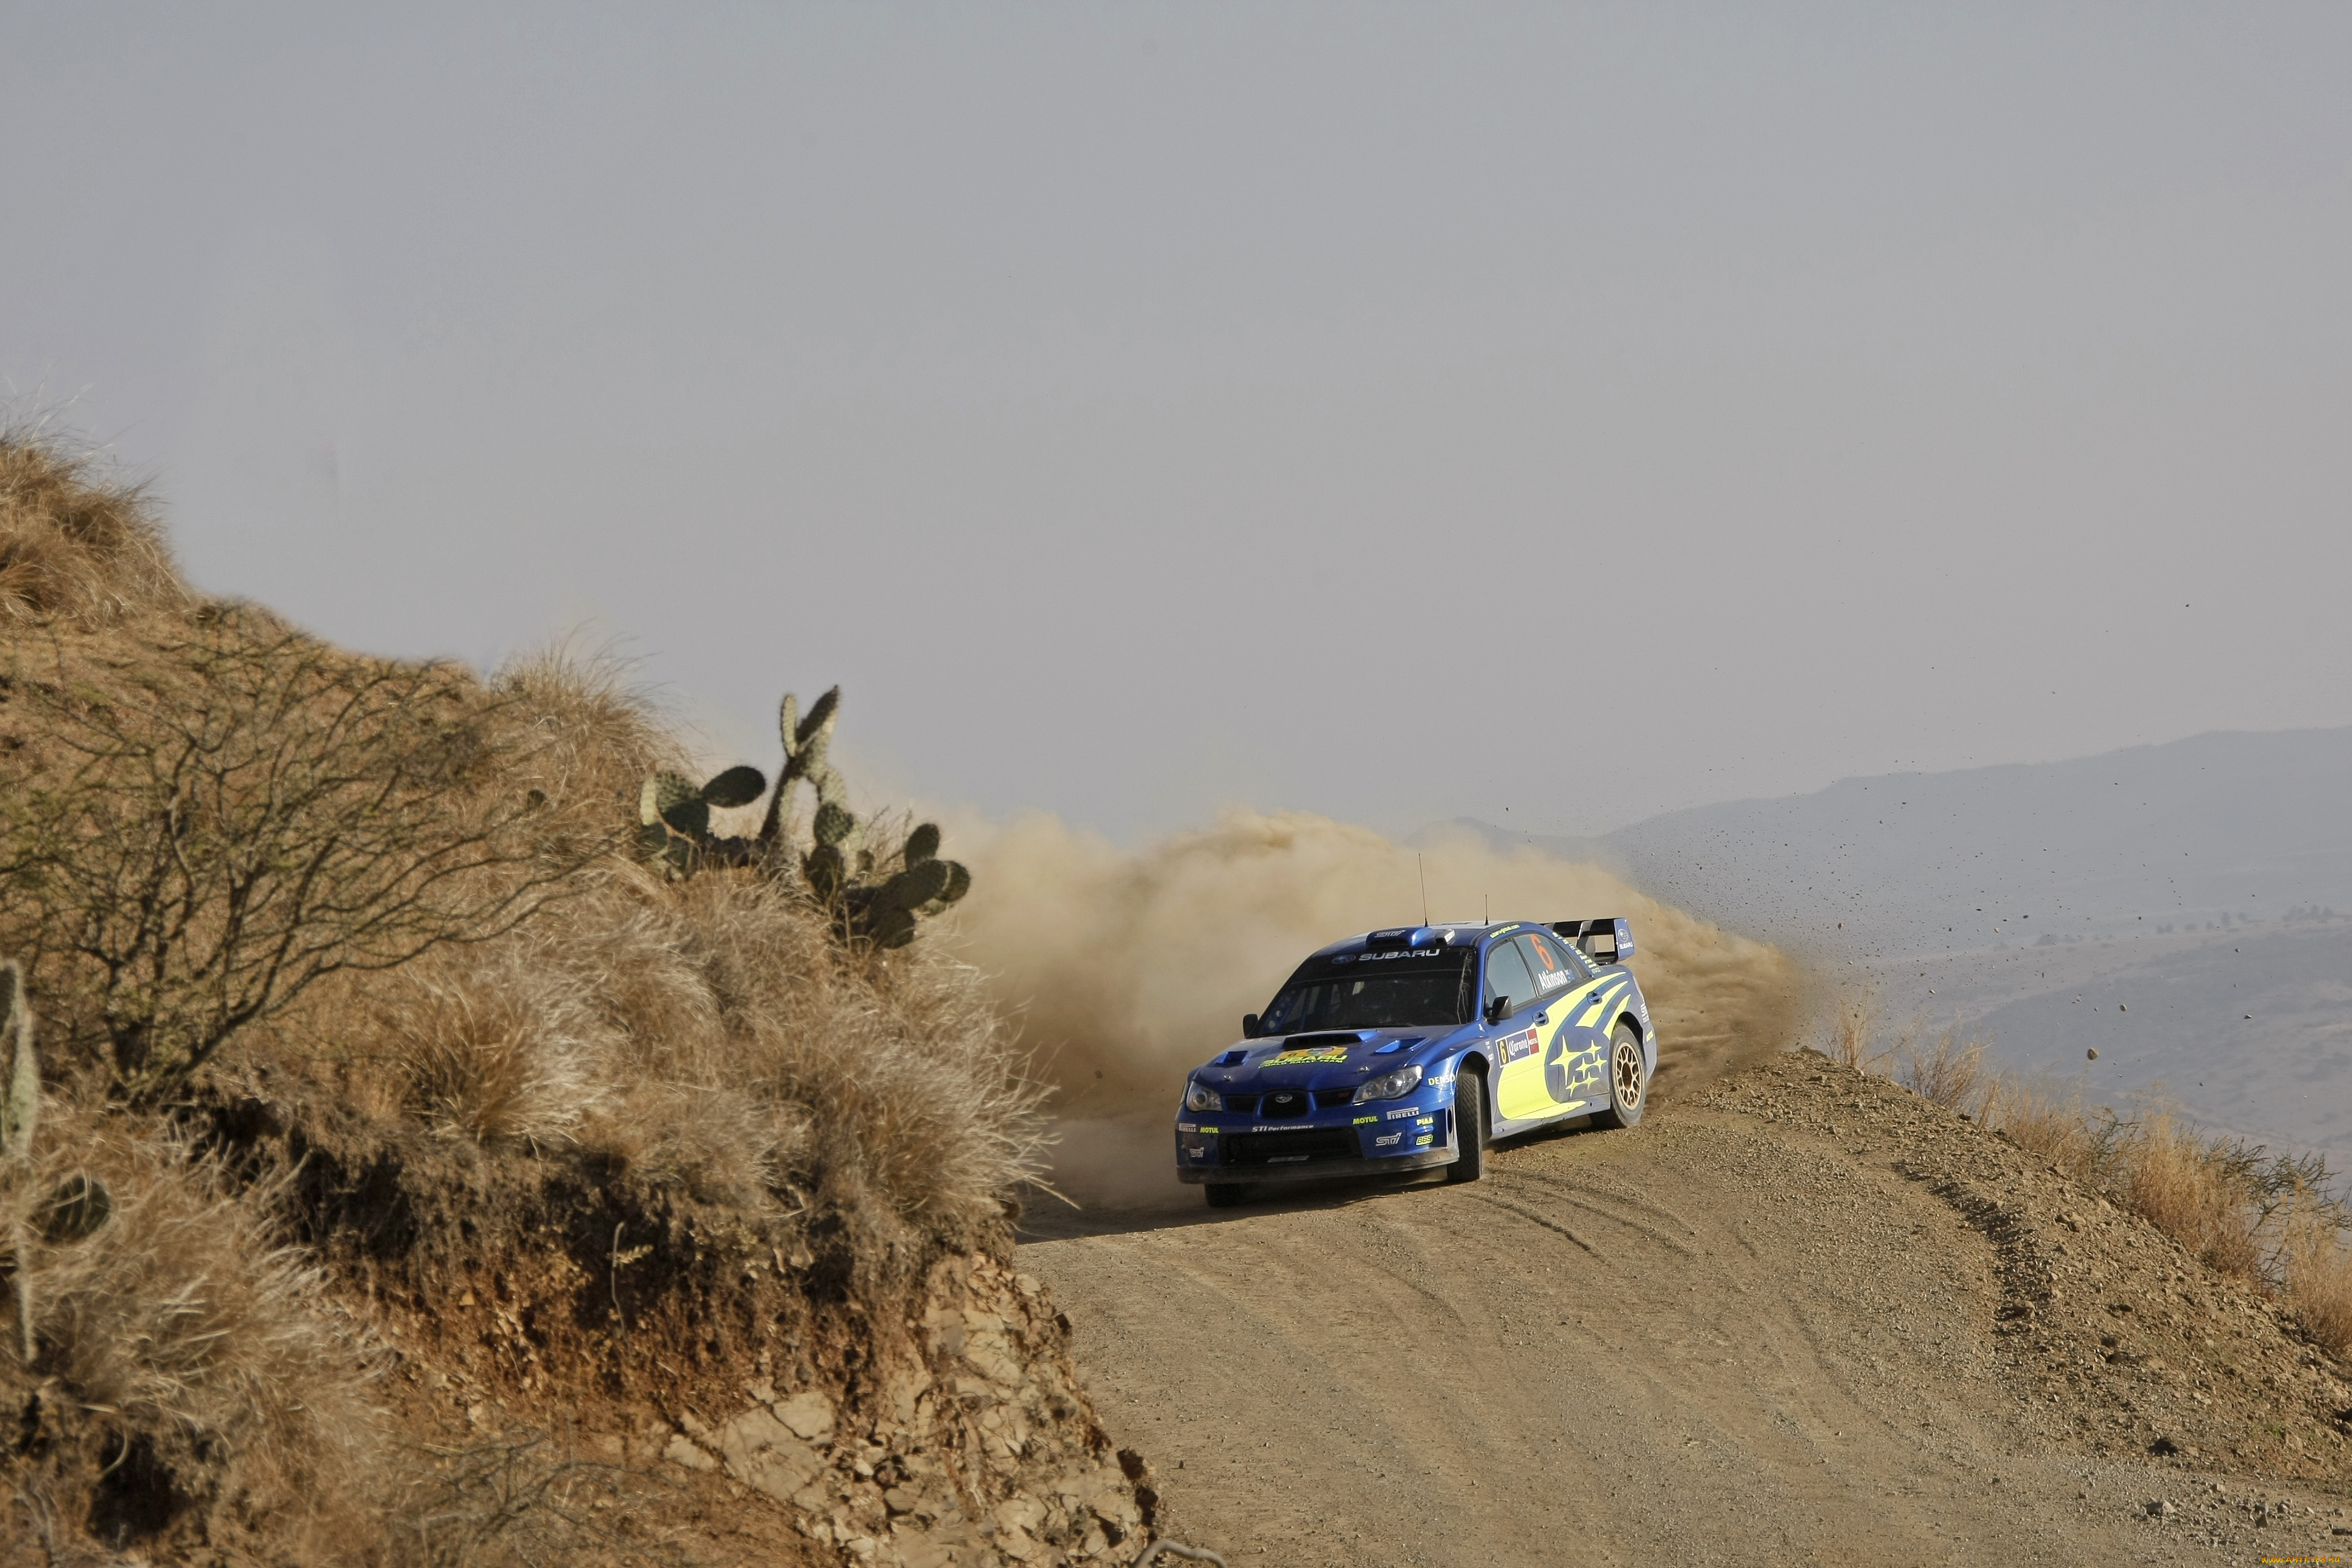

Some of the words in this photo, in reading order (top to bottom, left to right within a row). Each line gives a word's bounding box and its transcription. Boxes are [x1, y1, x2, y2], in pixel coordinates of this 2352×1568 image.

[1359, 949, 1440, 961] SUBARU
[1530, 933, 1555, 970] 6
[1538, 970, 1568, 990] Atkinson
[1500, 1040, 1507, 1063] 6
[1259, 1055, 1348, 1067] SUBARU
[1428, 1074, 1455, 1085] DENSO
[1387, 1107, 1419, 1120] PIRELLI
[1353, 1116, 1378, 1125] MOTUL
[1416, 1117, 1434, 1126] PIAA
